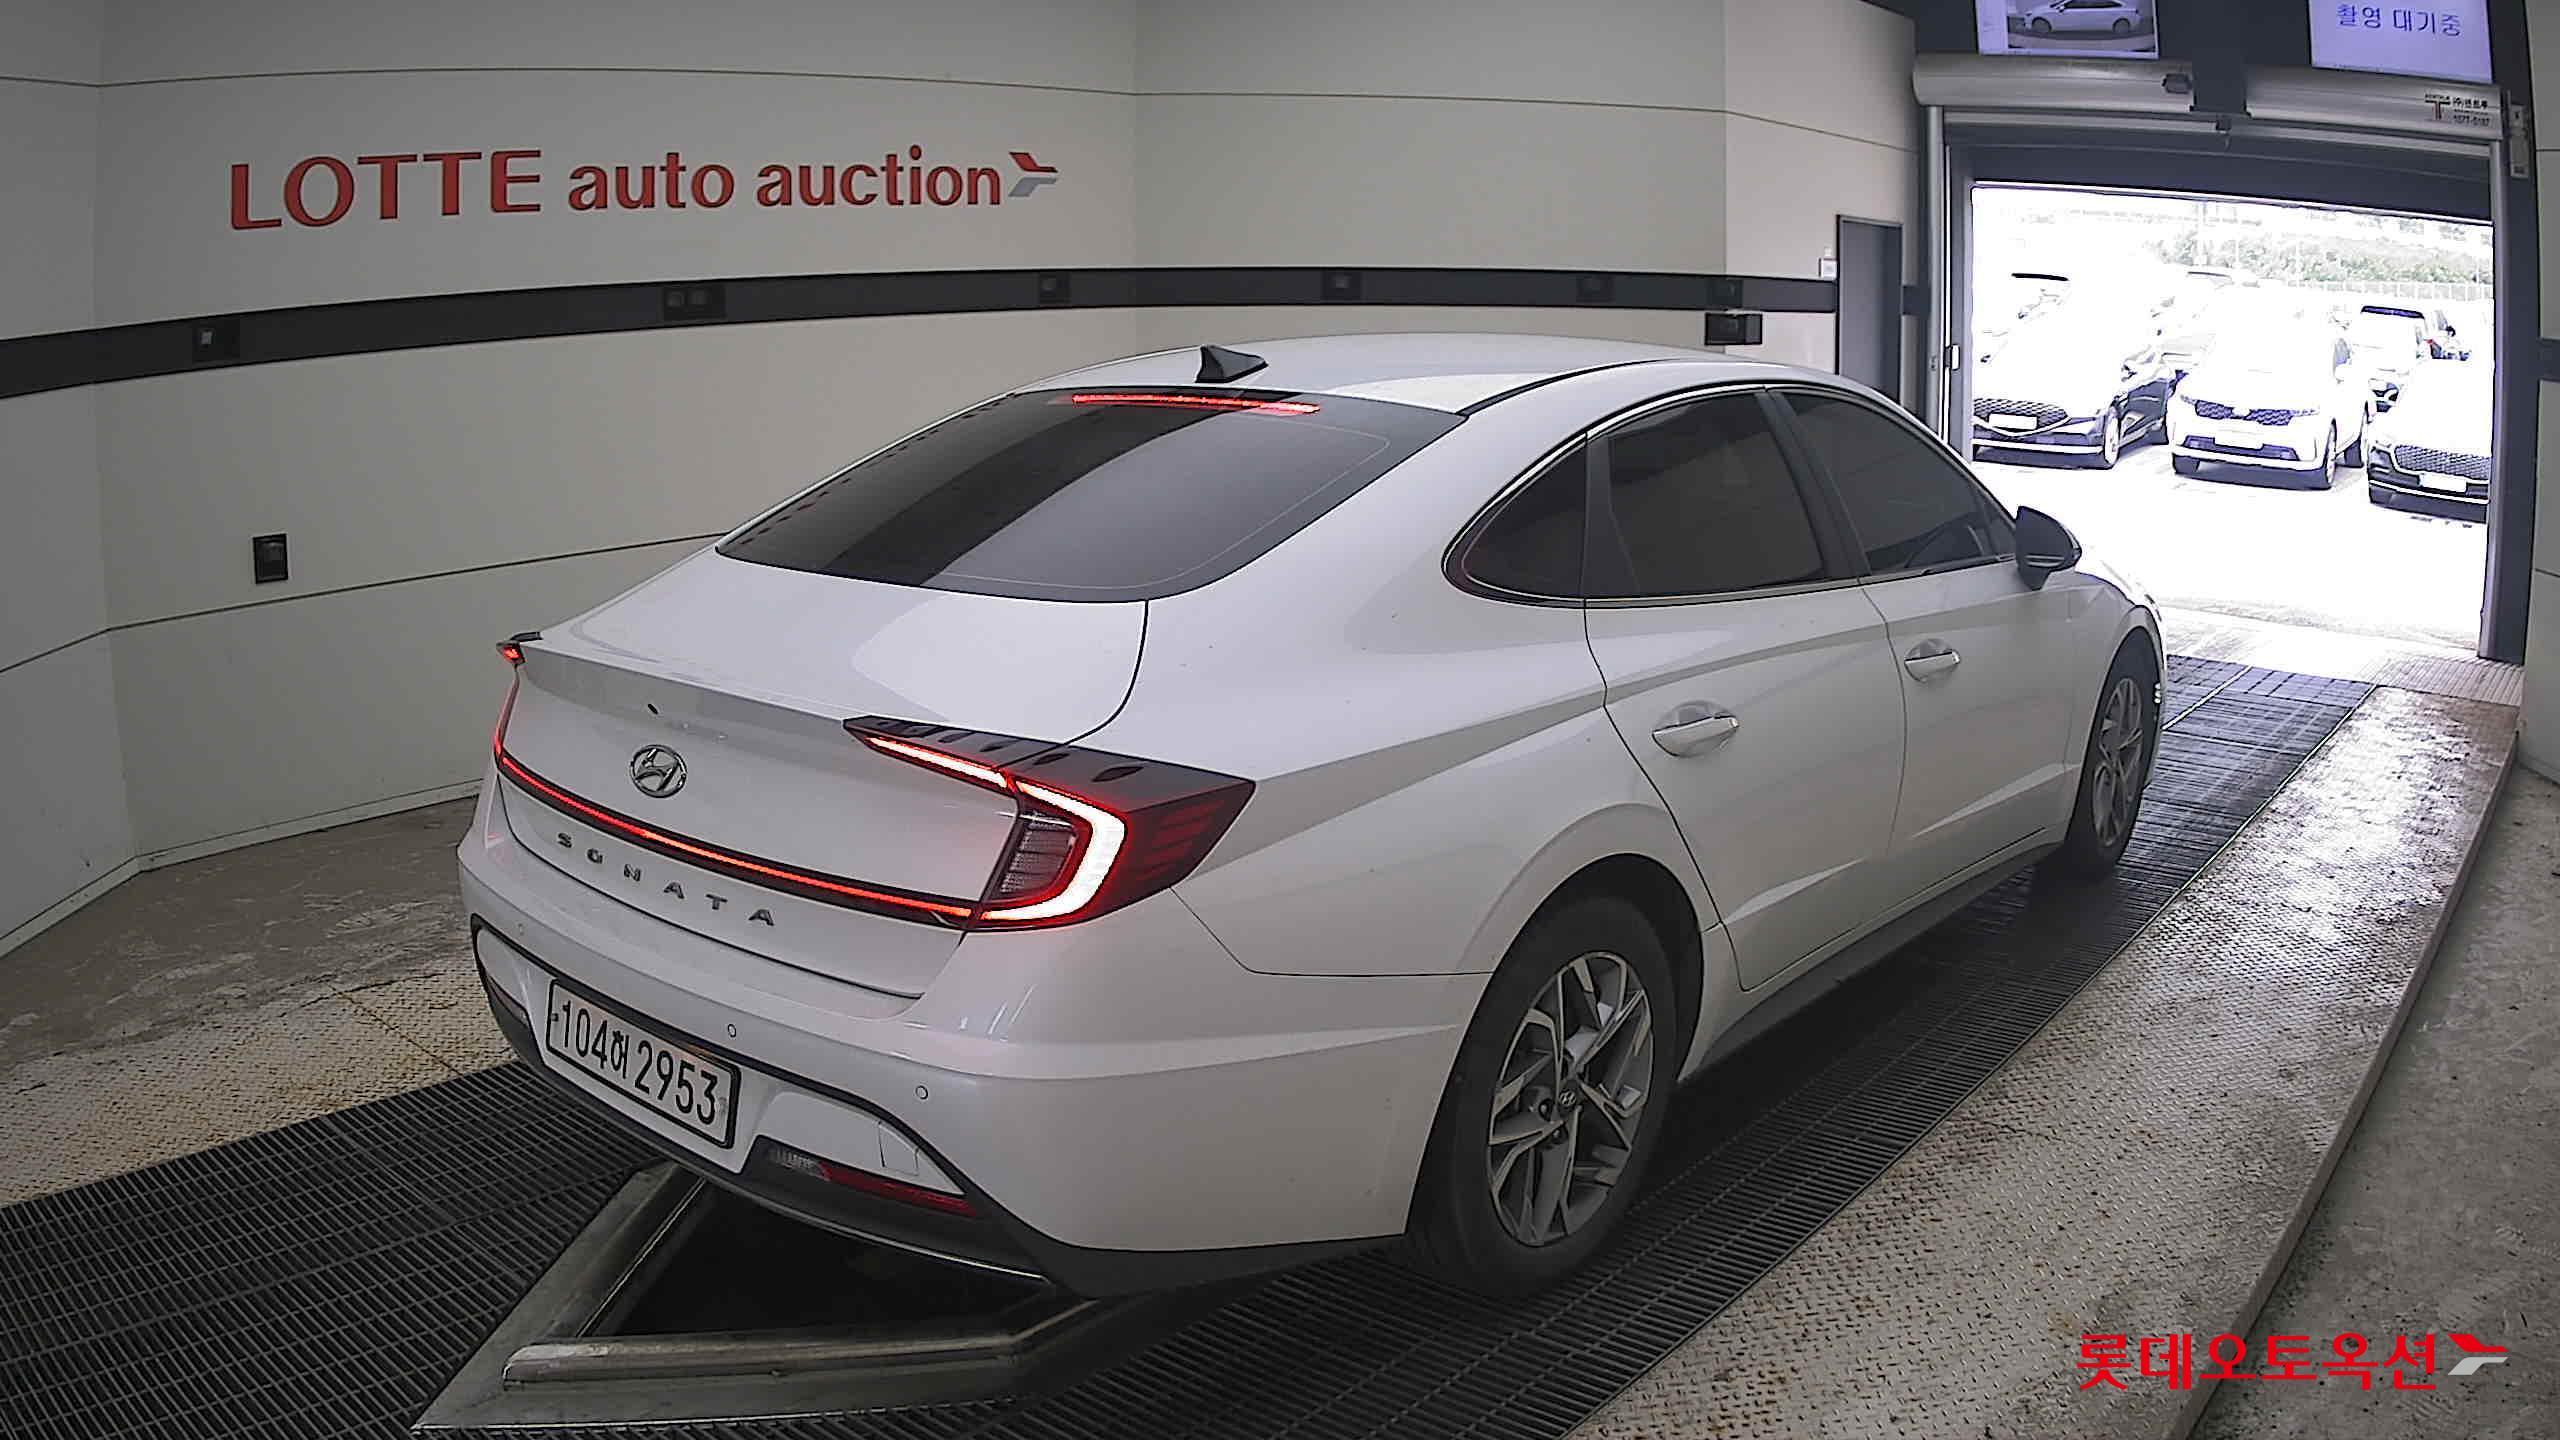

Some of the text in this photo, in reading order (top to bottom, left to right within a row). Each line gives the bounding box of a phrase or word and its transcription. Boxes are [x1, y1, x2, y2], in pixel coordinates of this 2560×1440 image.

[2337, 3, 2461, 37] 촬영 대기중
[231, 145, 1002, 230] LOTTE auto auction
[558, 832, 774, 926] SONATA
[562, 1000, 718, 1125] 104허 2953
